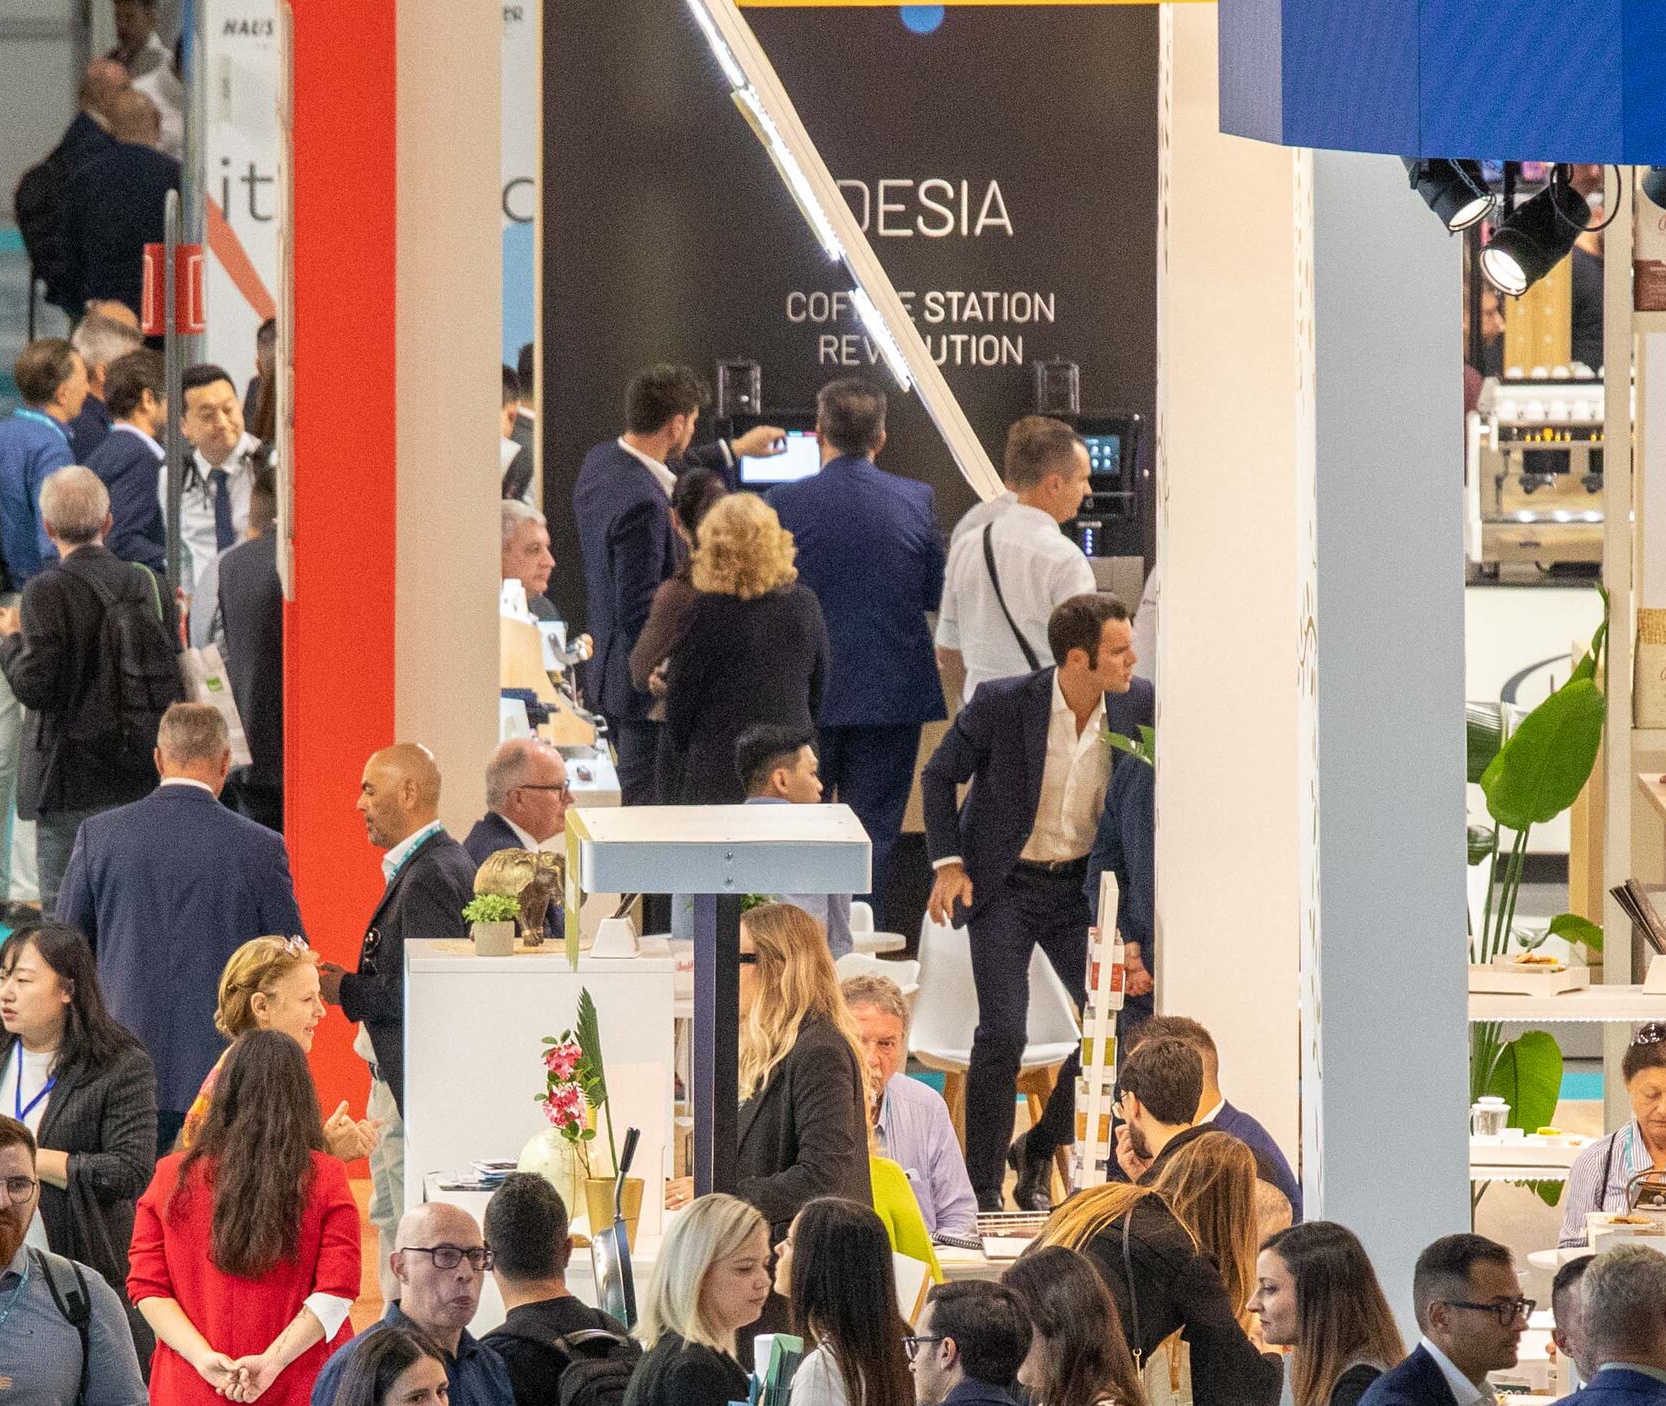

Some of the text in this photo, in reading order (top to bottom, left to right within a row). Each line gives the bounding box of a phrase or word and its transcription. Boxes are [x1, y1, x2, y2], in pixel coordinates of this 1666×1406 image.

[786, 291, 1055, 323] COFE STATION
[819, 334, 1023, 366] REVUTION
